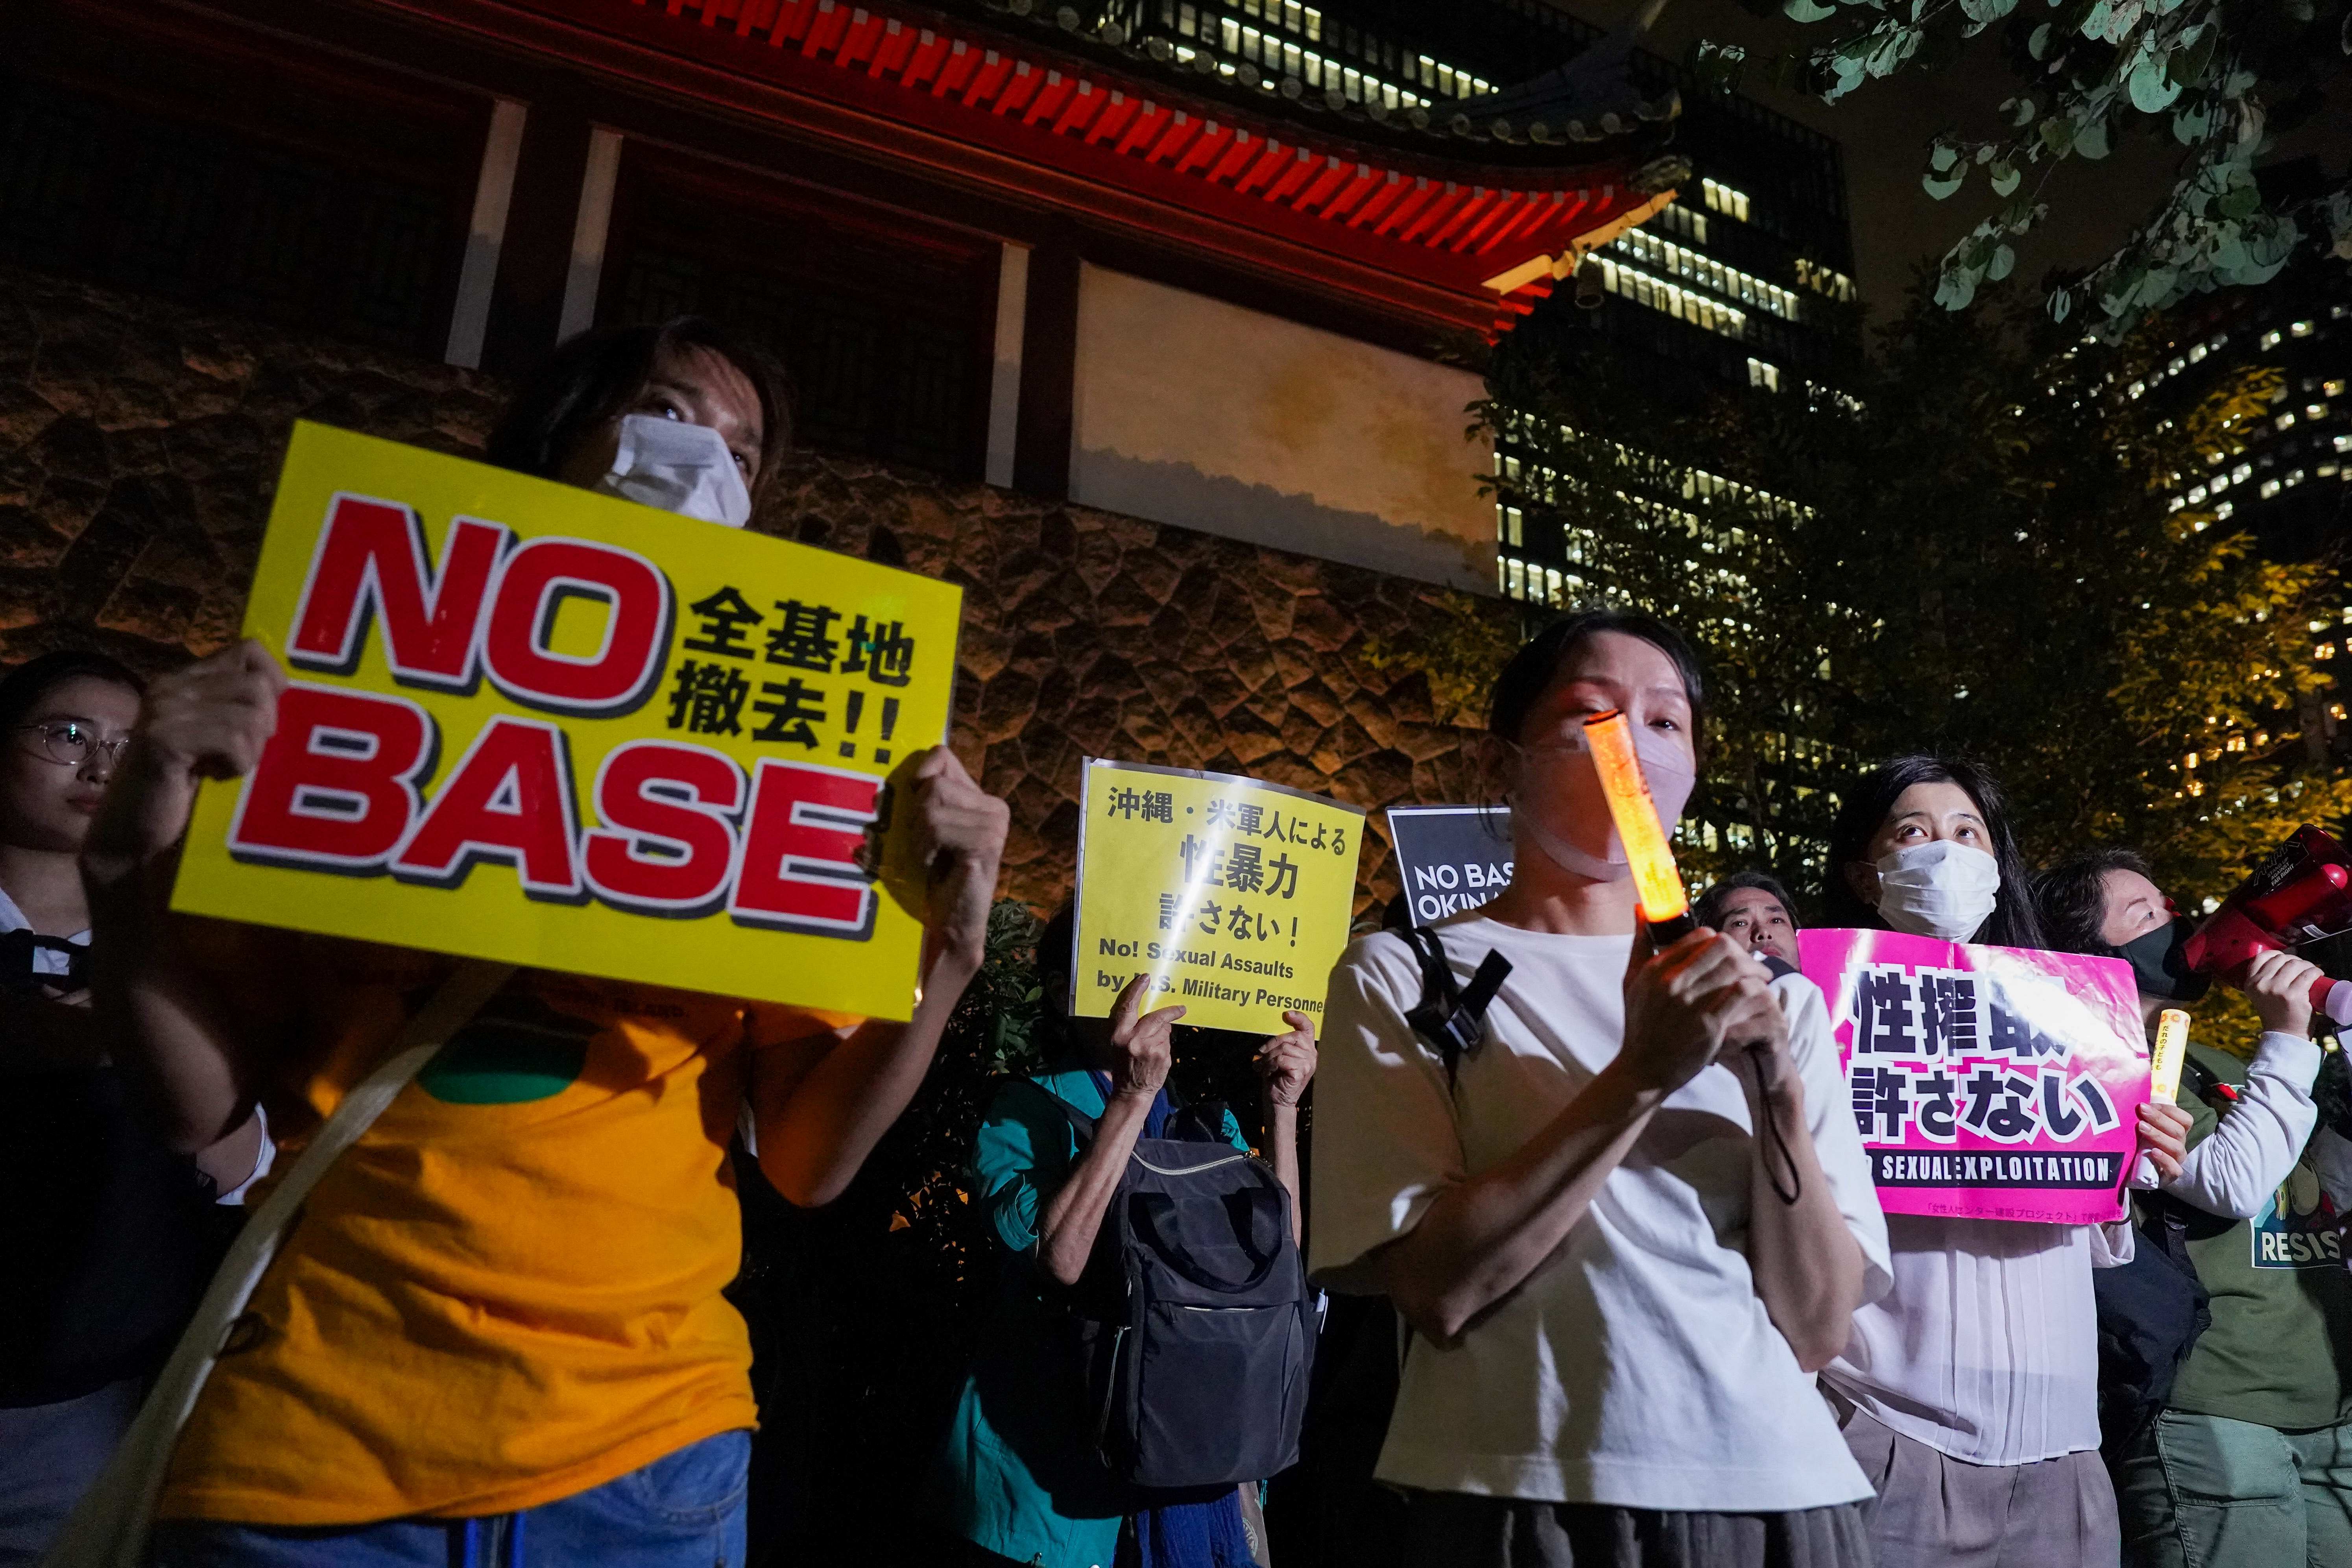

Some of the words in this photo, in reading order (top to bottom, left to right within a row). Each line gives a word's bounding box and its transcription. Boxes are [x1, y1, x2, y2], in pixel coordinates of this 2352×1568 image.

[286, 491, 674, 717] NO
[683, 586, 915, 687] 全基地
[667, 660, 900, 764] 撤去!!
[227, 681, 885, 940] BASE
[1107, 787, 1346, 856] 沖縄・米軍人による
[1180, 834, 1298, 899] 性暴力
[1414, 864, 1459, 890] NO
[2271, 862, 2289, 881] AGAINST
[2271, 876, 2281, 887] FAR
[2280, 863, 2294, 878] RIGHT
[1159, 893, 1298, 947] 許さない！
[1418, 891, 1499, 920] OKIN
[1099, 938, 1138, 957] No!
[1147, 942, 1215, 967] Sexual
[1221, 953, 1293, 978] Assaults
[1097, 970, 1125, 992] by
[1134, 972, 1176, 993] .S.
[1182, 978, 1250, 1007] Military
[1851, 1066, 2113, 1137] 許さない
[1882, 1155, 1952, 1180] SEXUAL
[2262, 1230, 2341, 1262] RESIS
